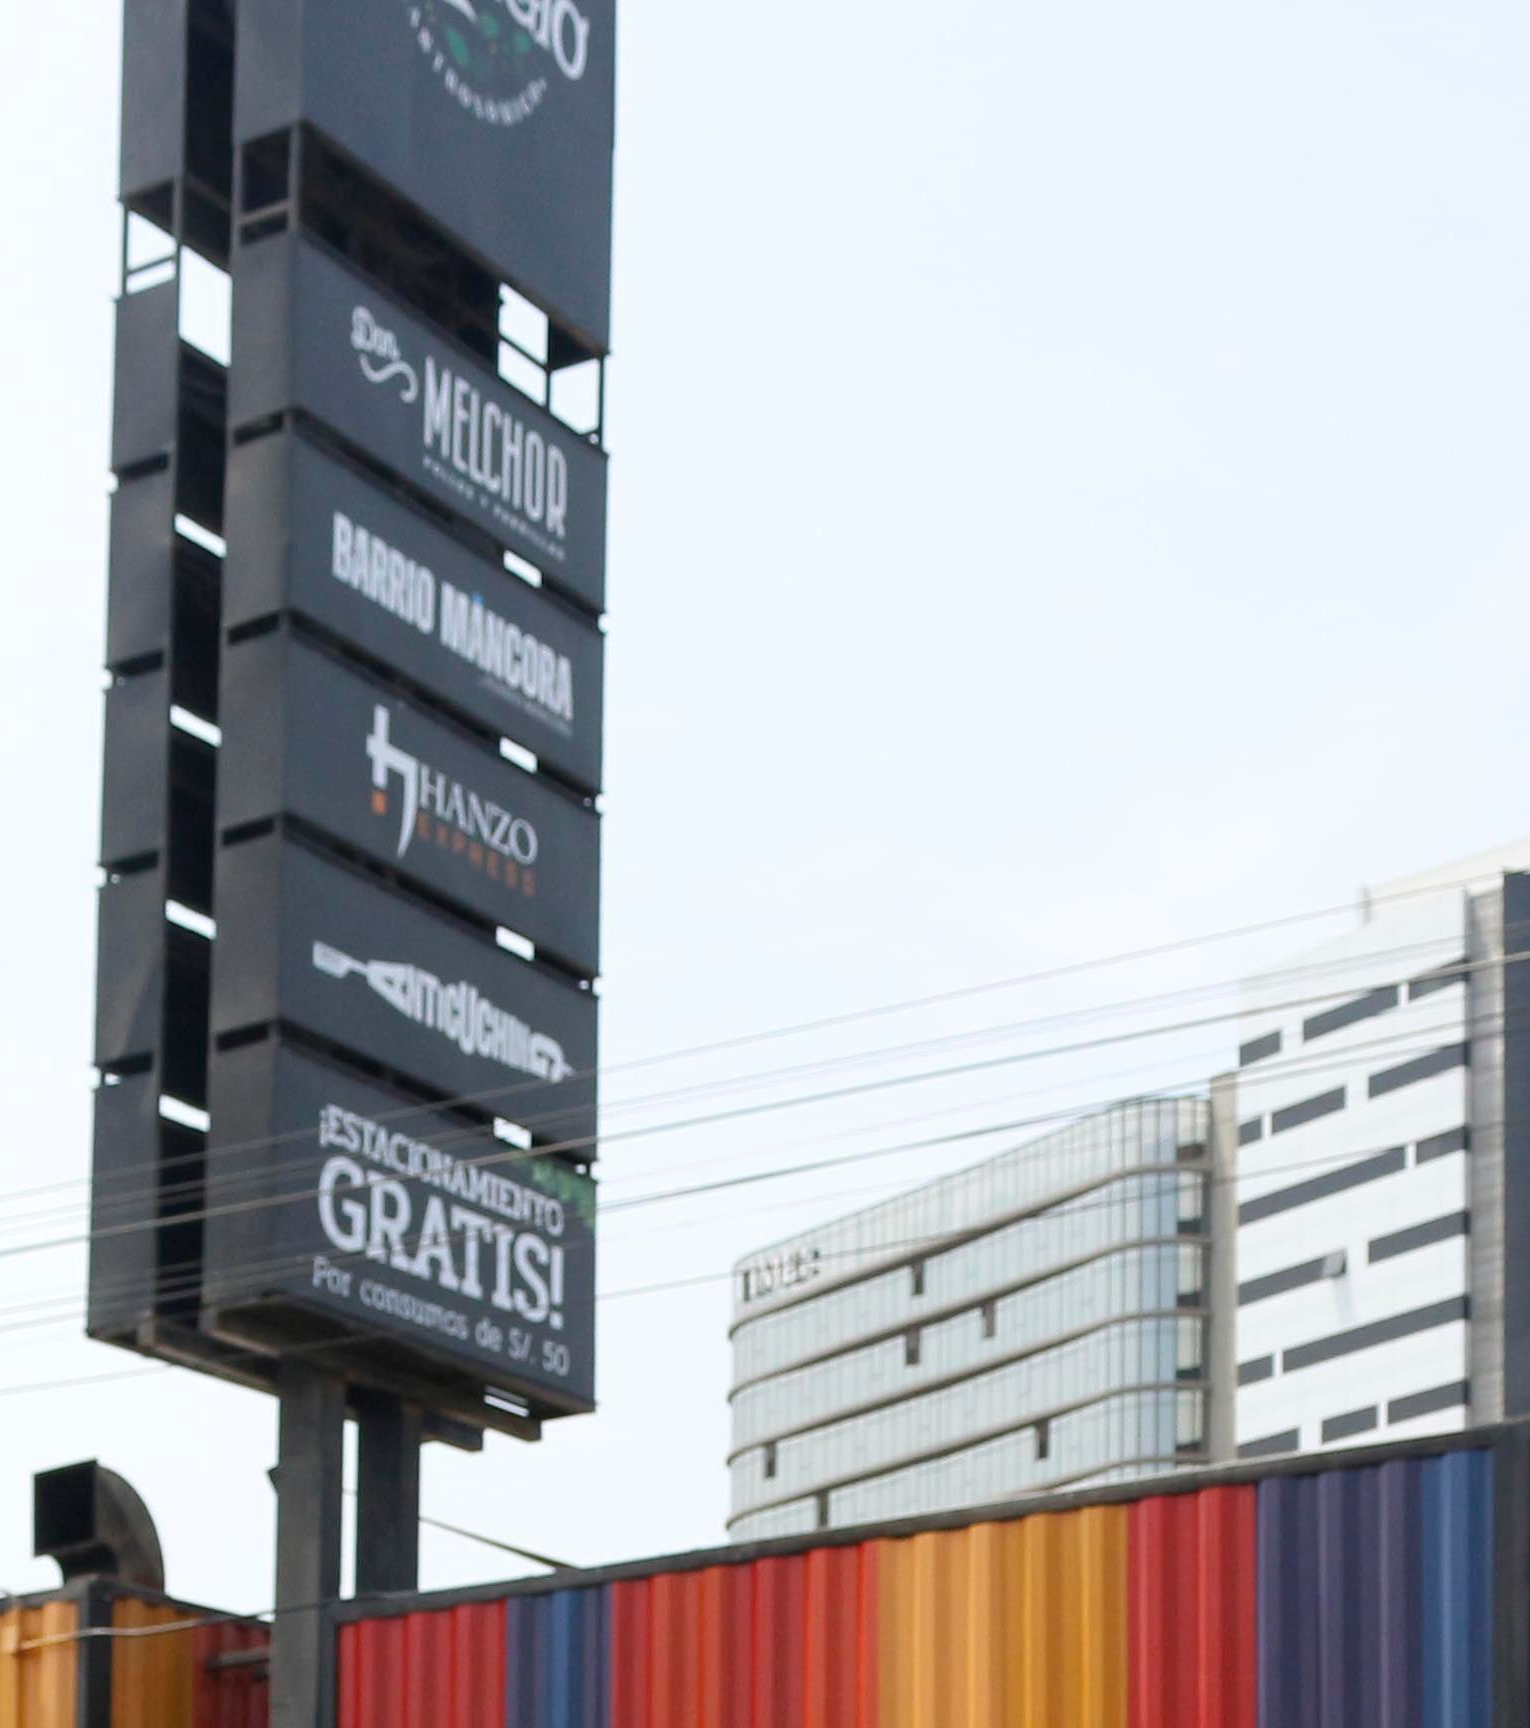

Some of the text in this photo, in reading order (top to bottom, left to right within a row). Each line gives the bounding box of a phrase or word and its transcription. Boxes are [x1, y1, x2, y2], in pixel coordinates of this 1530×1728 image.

[423, 354, 568, 539] MELCHOR
[332, 510, 436, 635] BARRIO
[419, 764, 539, 866] HANZO
[318, 1155, 565, 1331] GRATIS!
[312, 1255, 352, 1298] Por
[474, 1316, 503, 1353] de
[541, 1340, 571, 1377] 50
